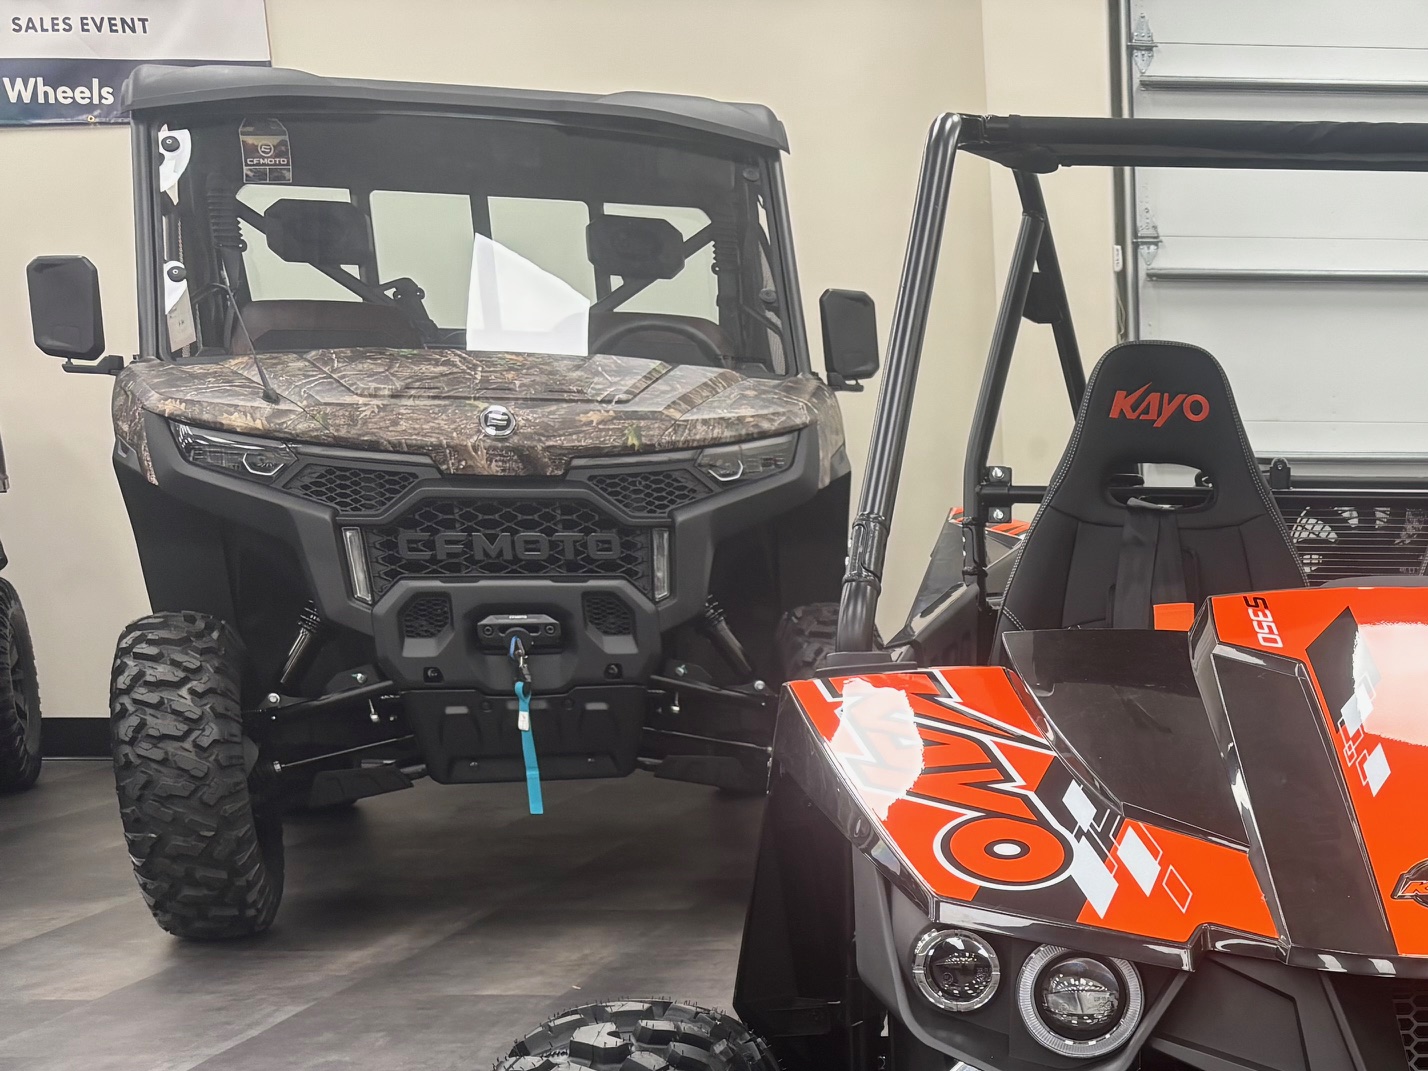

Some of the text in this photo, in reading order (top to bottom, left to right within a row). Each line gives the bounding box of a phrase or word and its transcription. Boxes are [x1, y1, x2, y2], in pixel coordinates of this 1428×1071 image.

[11, 16, 149, 34] SALES EVENT
[1, 76, 115, 105] Wheels
[1109, 381, 1210, 428] KAYO
[398, 532, 622, 560] CFMOTO
[1243, 595, 1284, 648] S350
